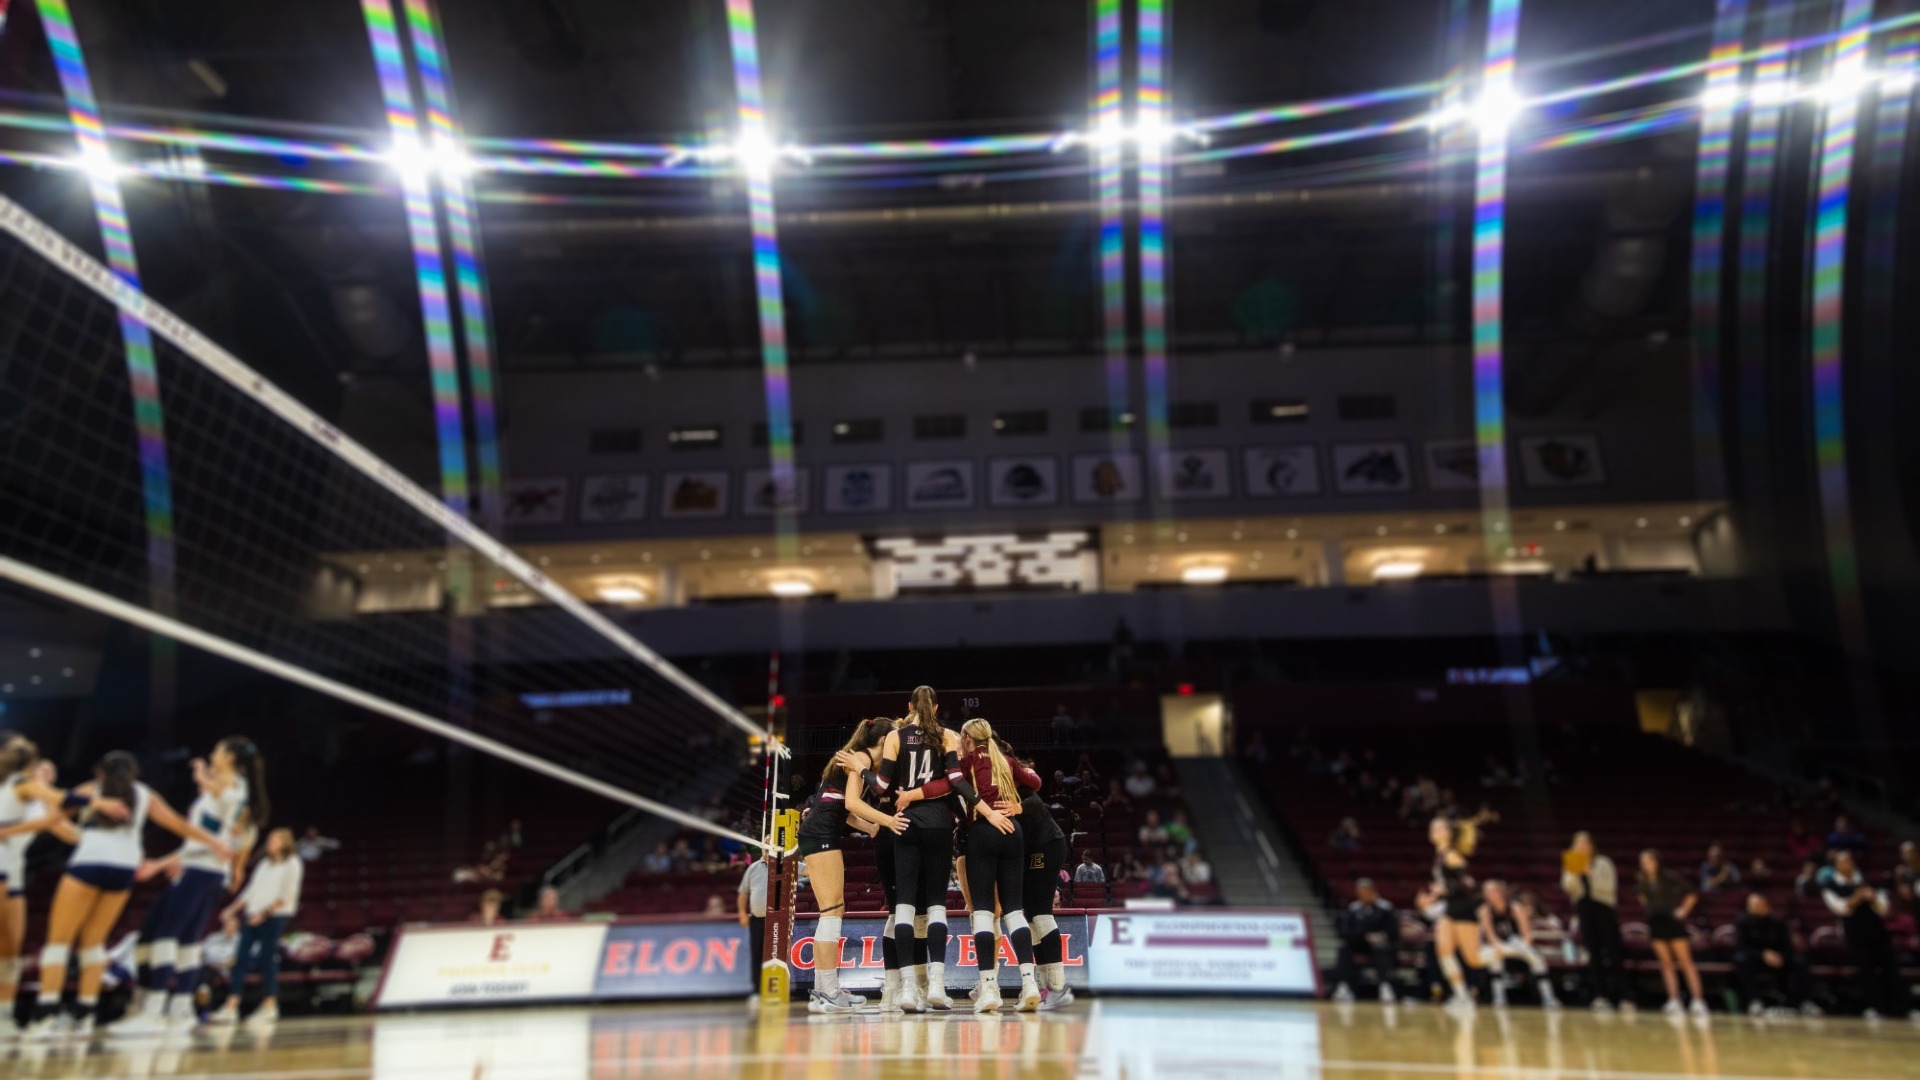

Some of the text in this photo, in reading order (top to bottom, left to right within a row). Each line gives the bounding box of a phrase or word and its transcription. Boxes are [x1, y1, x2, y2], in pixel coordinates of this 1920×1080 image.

[962, 697, 980, 708] 103
[908, 750, 933, 788] 14
[1030, 853, 1044, 869] E
[1109, 917, 1134, 945] E
[488, 933, 515, 962] E
[603, 938, 740, 975] ELON
[768, 978, 779, 992] E
